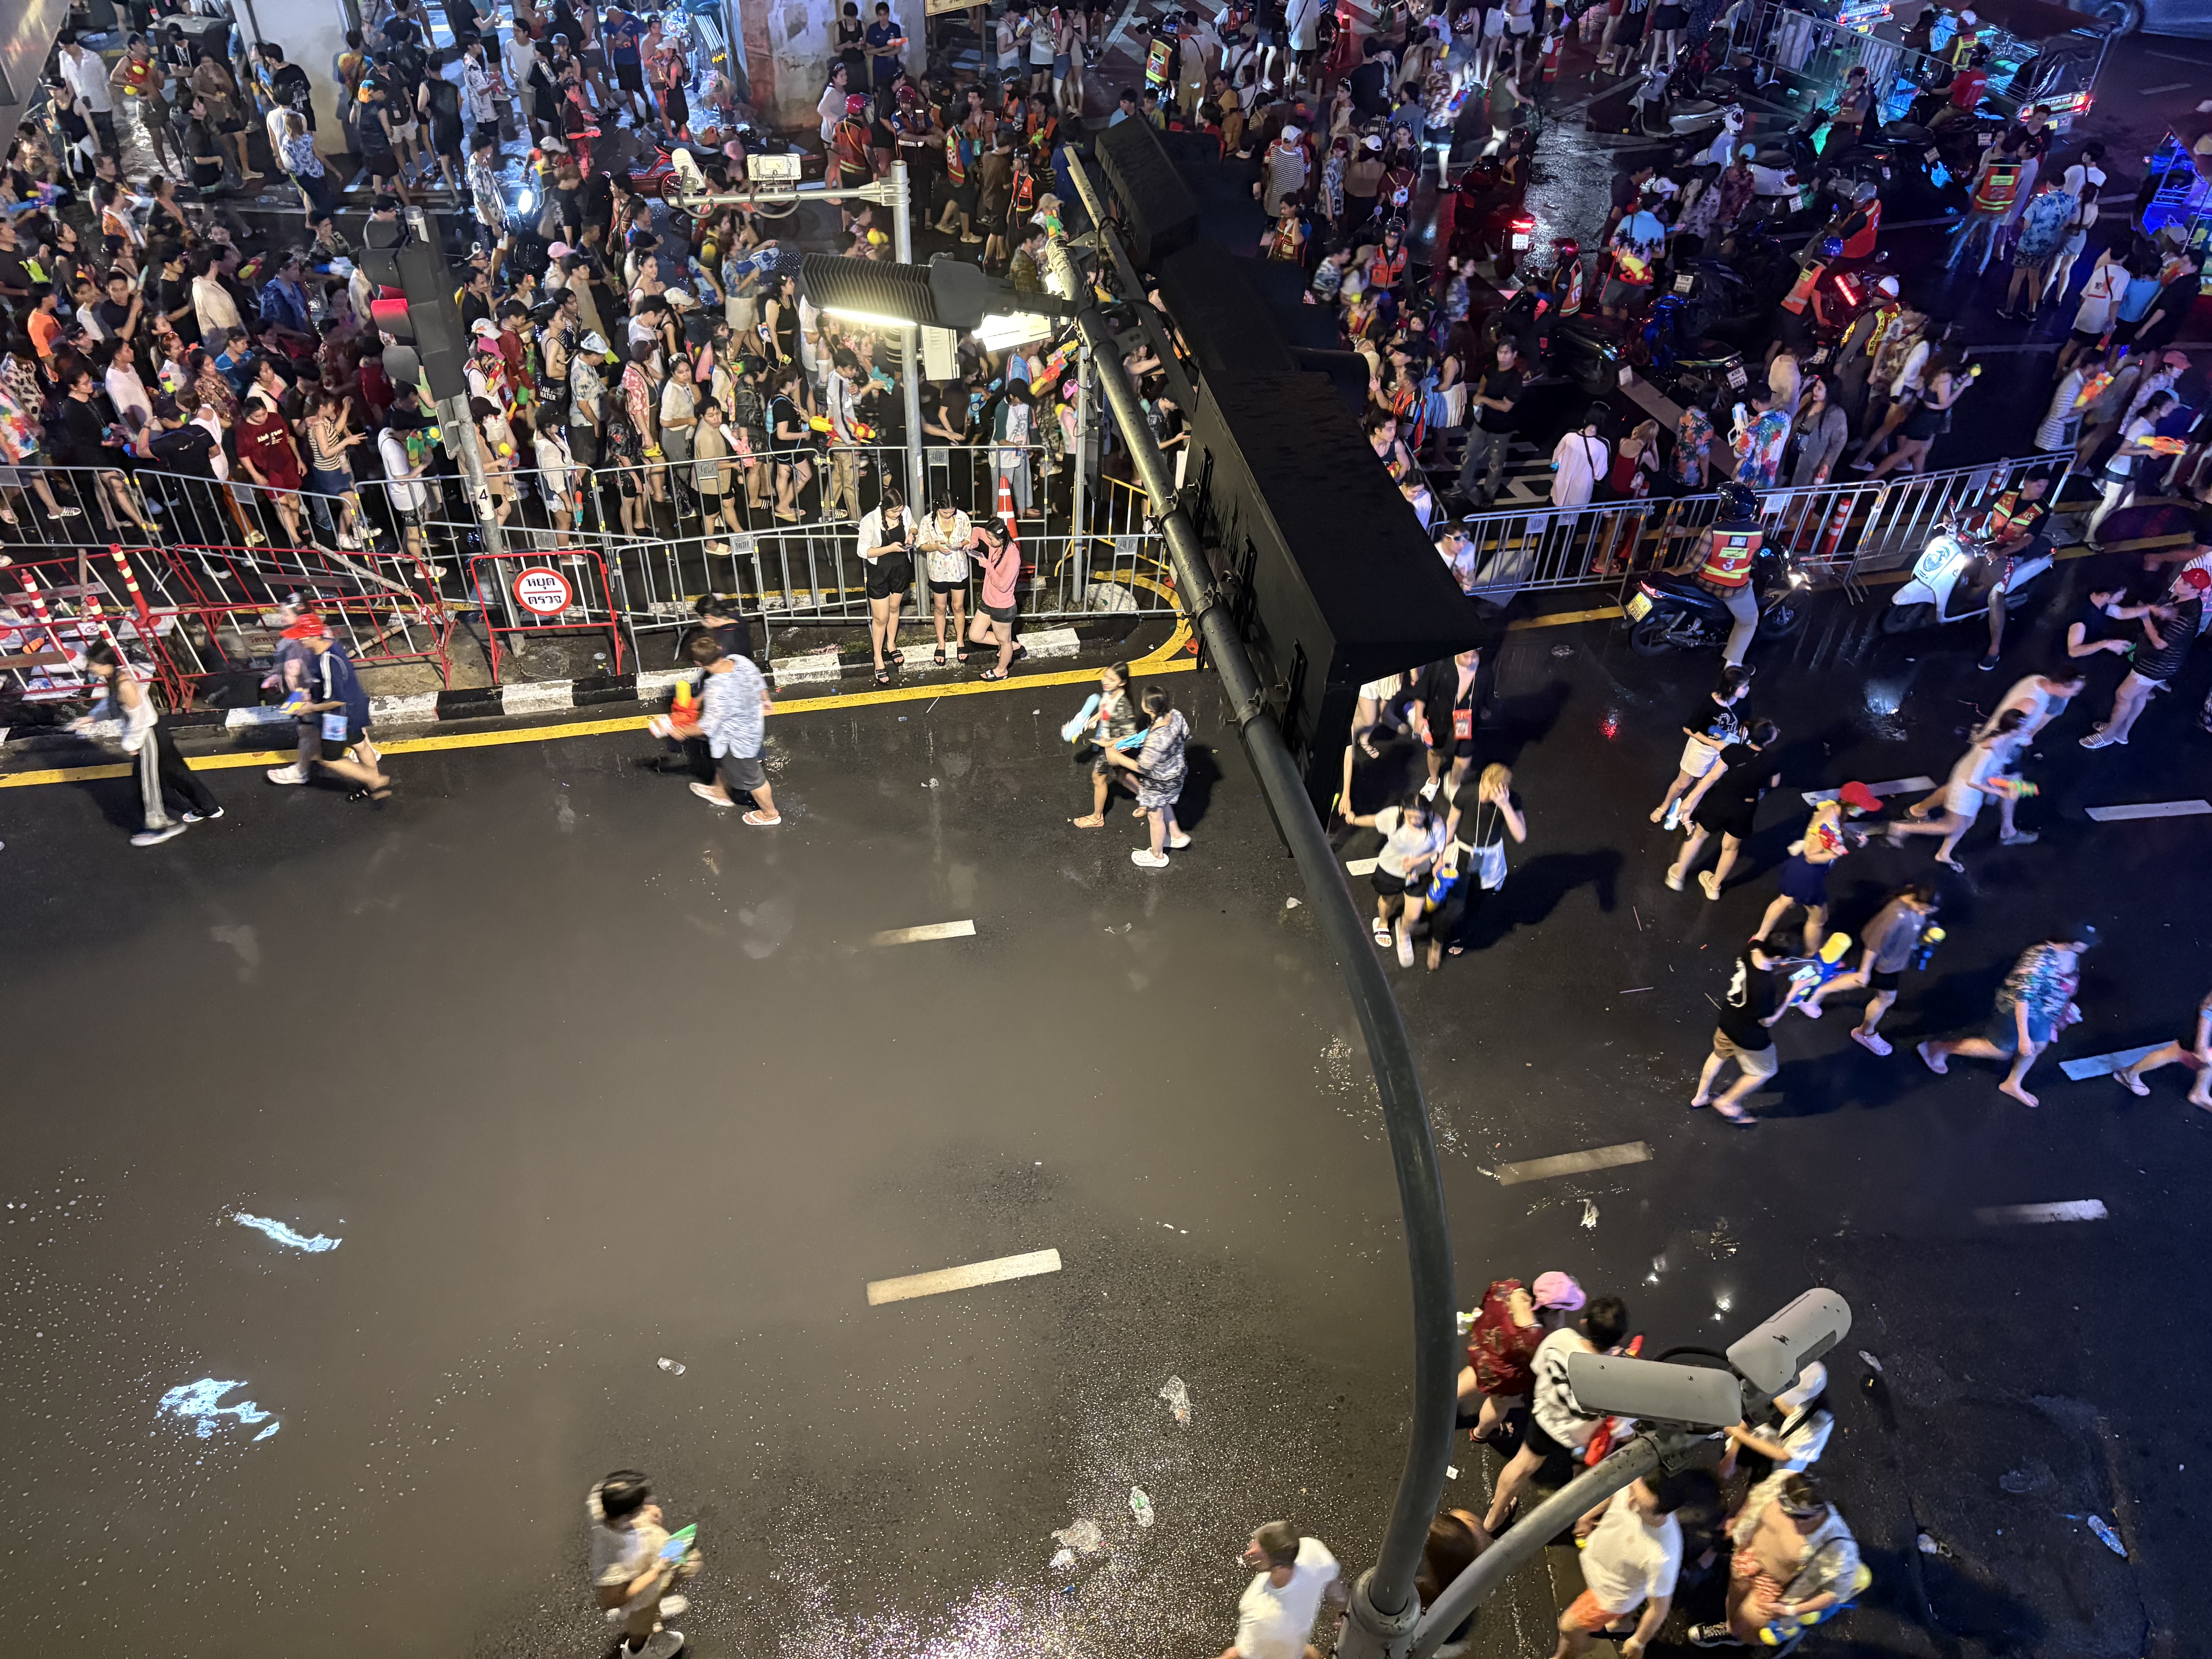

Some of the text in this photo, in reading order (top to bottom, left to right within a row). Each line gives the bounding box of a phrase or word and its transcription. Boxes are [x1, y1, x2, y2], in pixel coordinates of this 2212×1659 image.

[1151, 60, 1160, 74] 25
[540, 391, 556, 401] WATER
[479, 489, 488, 500] 4
[1723, 559, 1735, 571] 3
[526, 578, 555, 590] หยุด
[528, 596, 562, 605] ตรวจ
[1630, 605, 1640, 618] 7259
